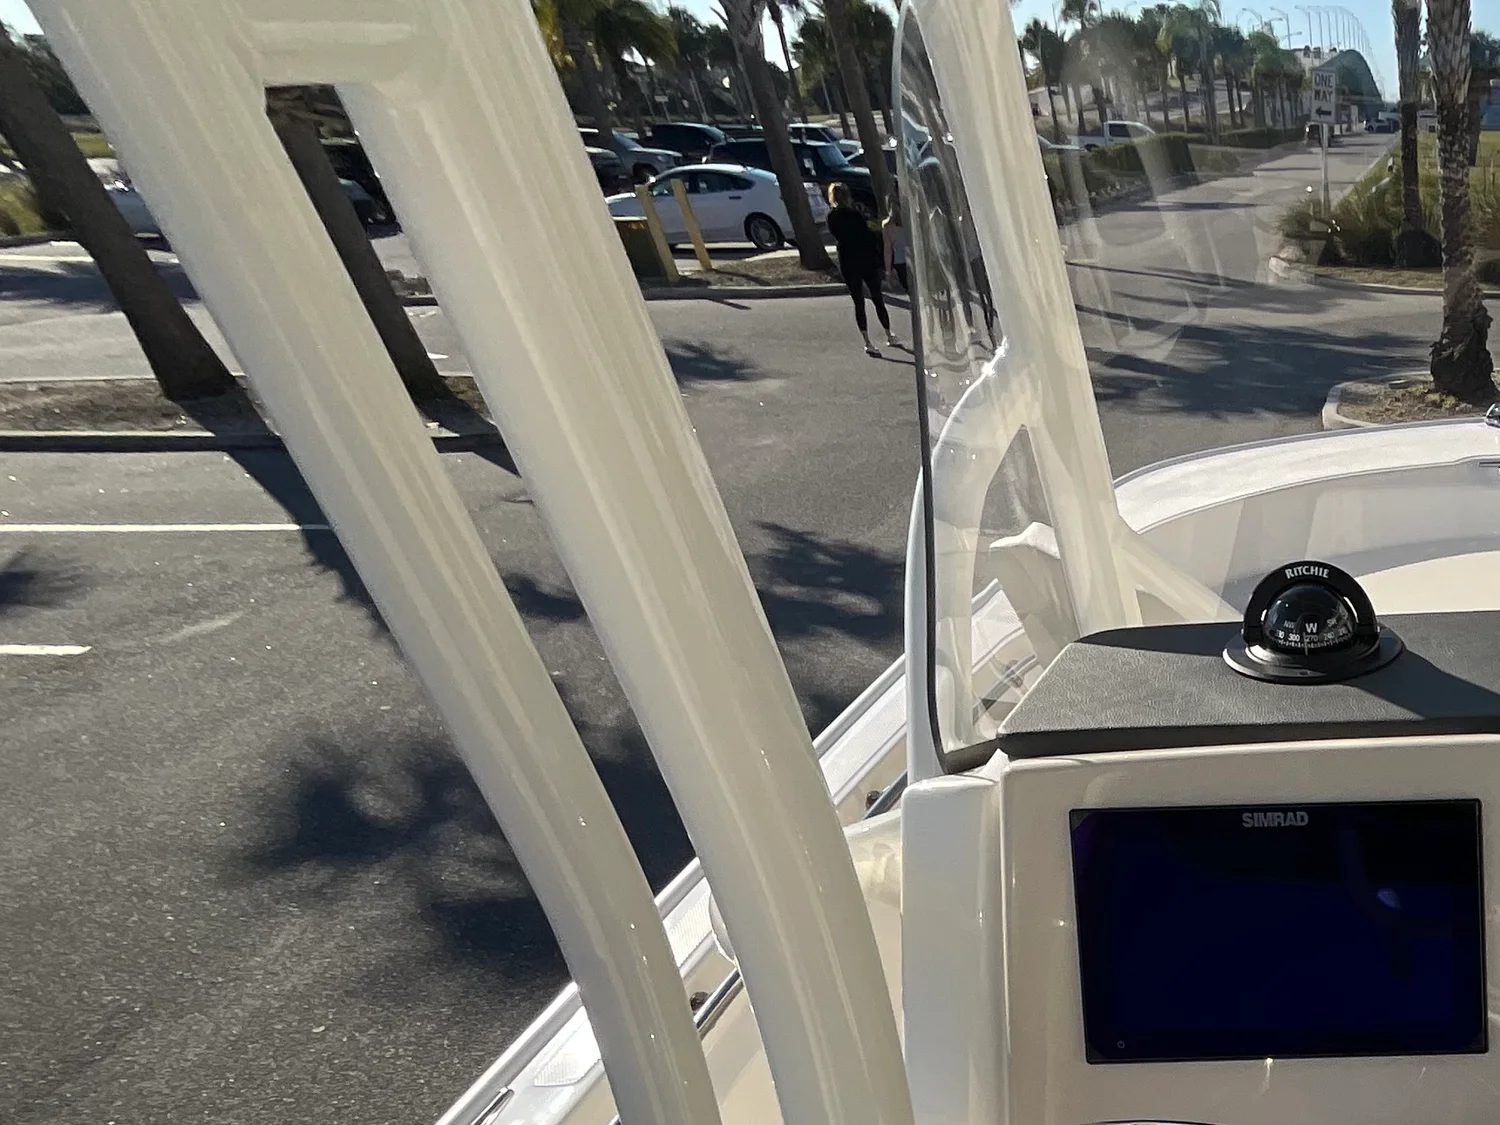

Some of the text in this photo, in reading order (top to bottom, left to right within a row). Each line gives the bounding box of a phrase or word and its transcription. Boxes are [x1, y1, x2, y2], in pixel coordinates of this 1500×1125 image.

[1314, 73, 1333, 88] ONE
[1314, 89, 1333, 103] WAY
[1285, 566, 1329, 579] RITCHIE
[1305, 622, 1318, 633] W
[1242, 811, 1309, 828] SIMRAD
